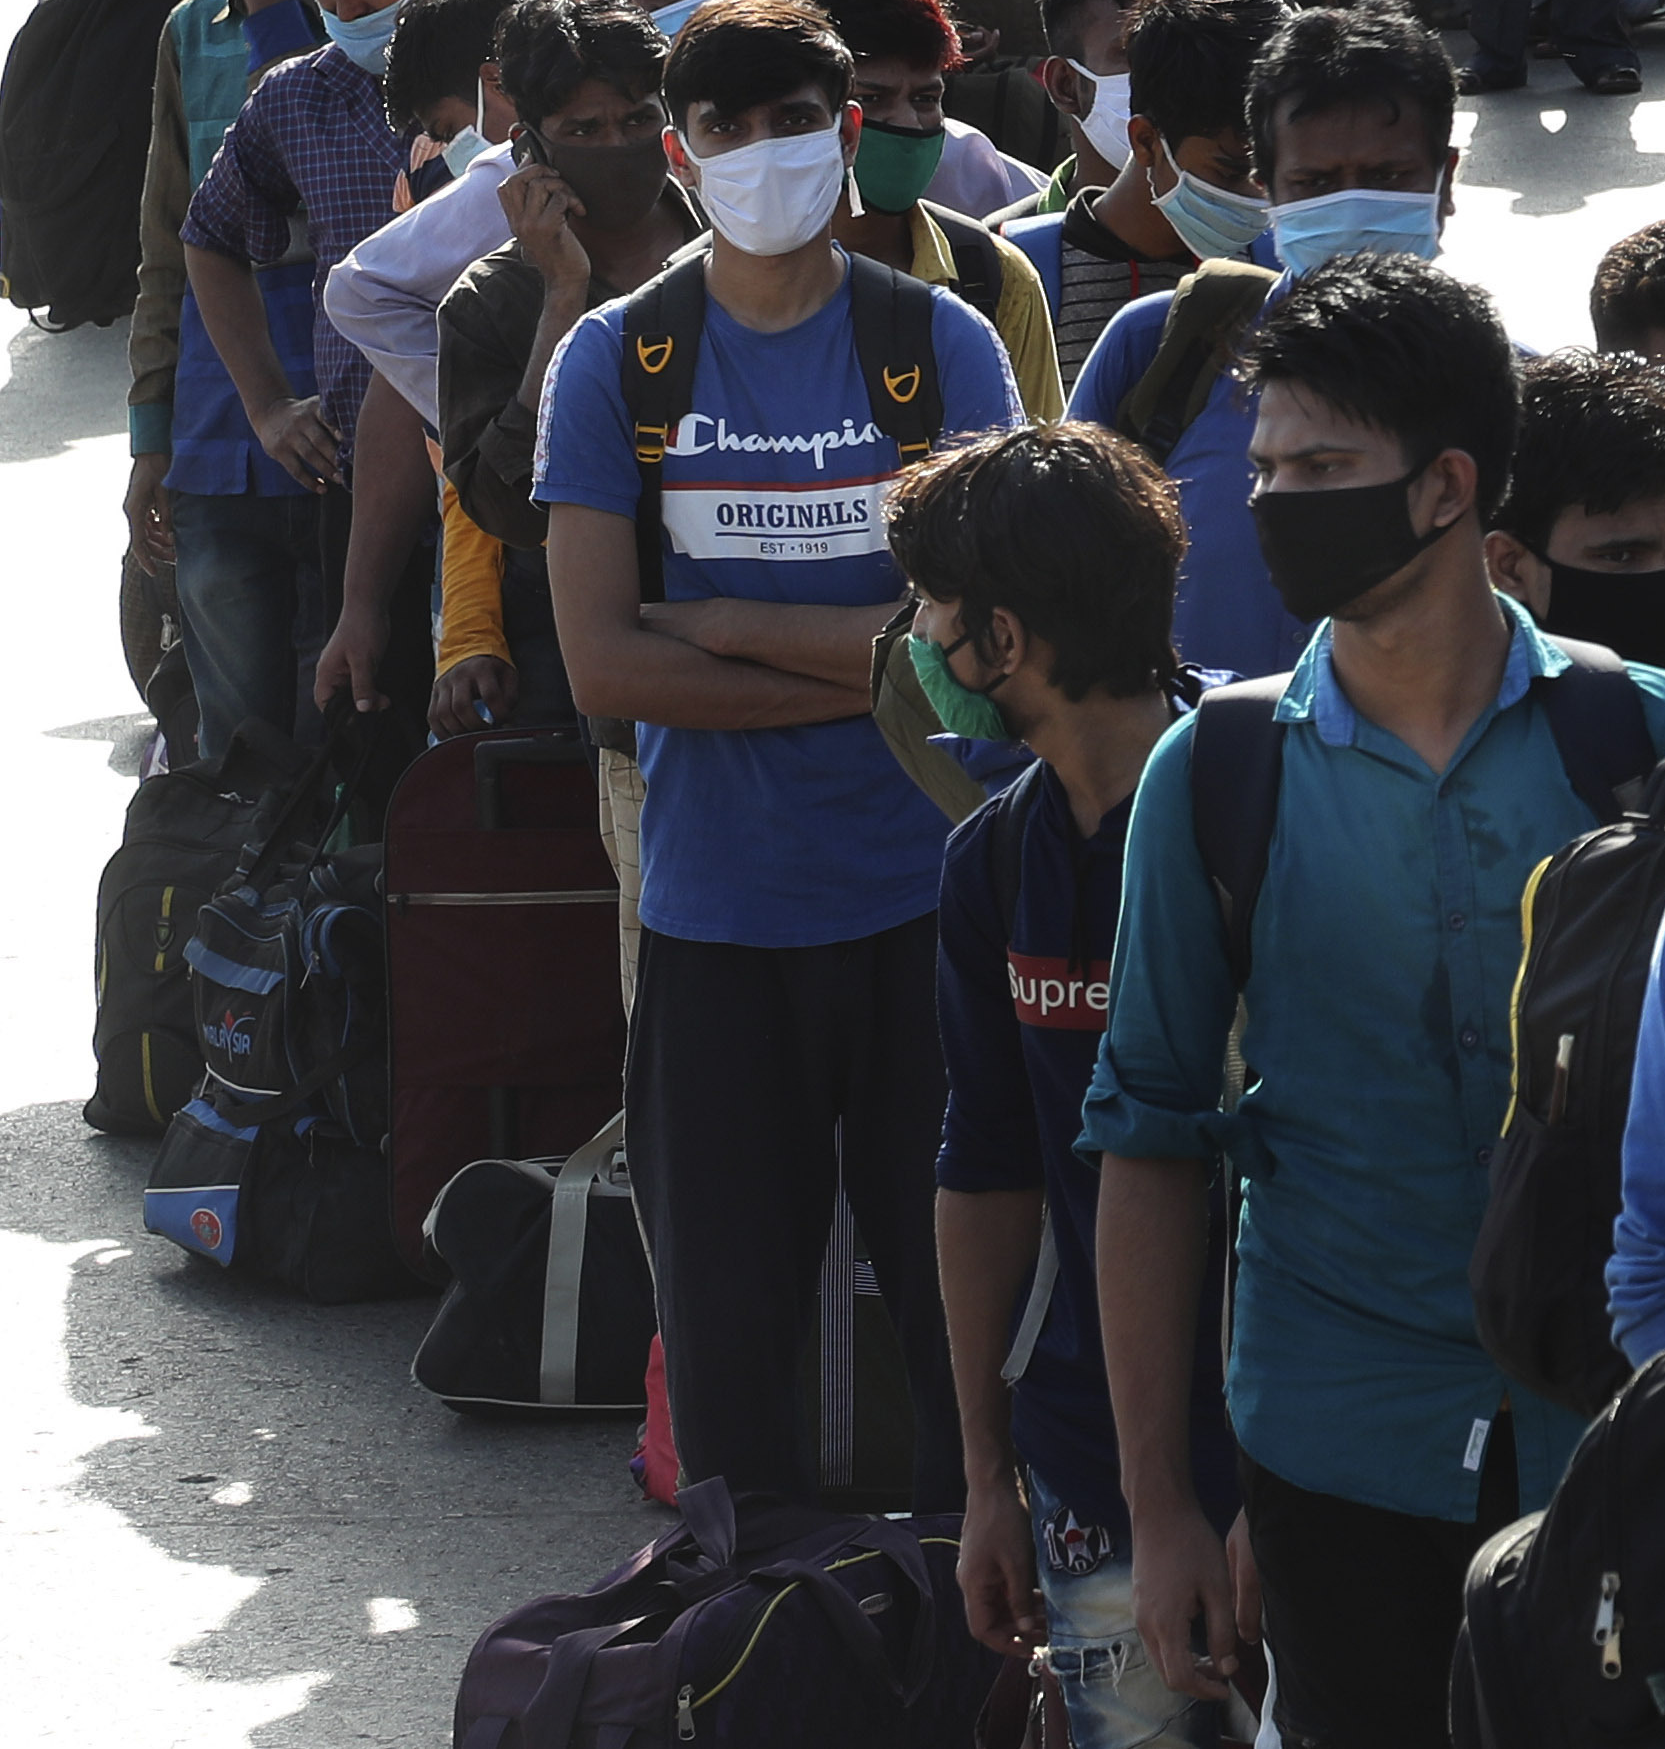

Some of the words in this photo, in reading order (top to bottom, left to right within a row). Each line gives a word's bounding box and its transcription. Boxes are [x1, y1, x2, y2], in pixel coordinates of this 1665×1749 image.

[717, 499, 868, 528] ORIGINALS
[760, 542, 785, 554] EST
[799, 542, 828, 554] 1919
